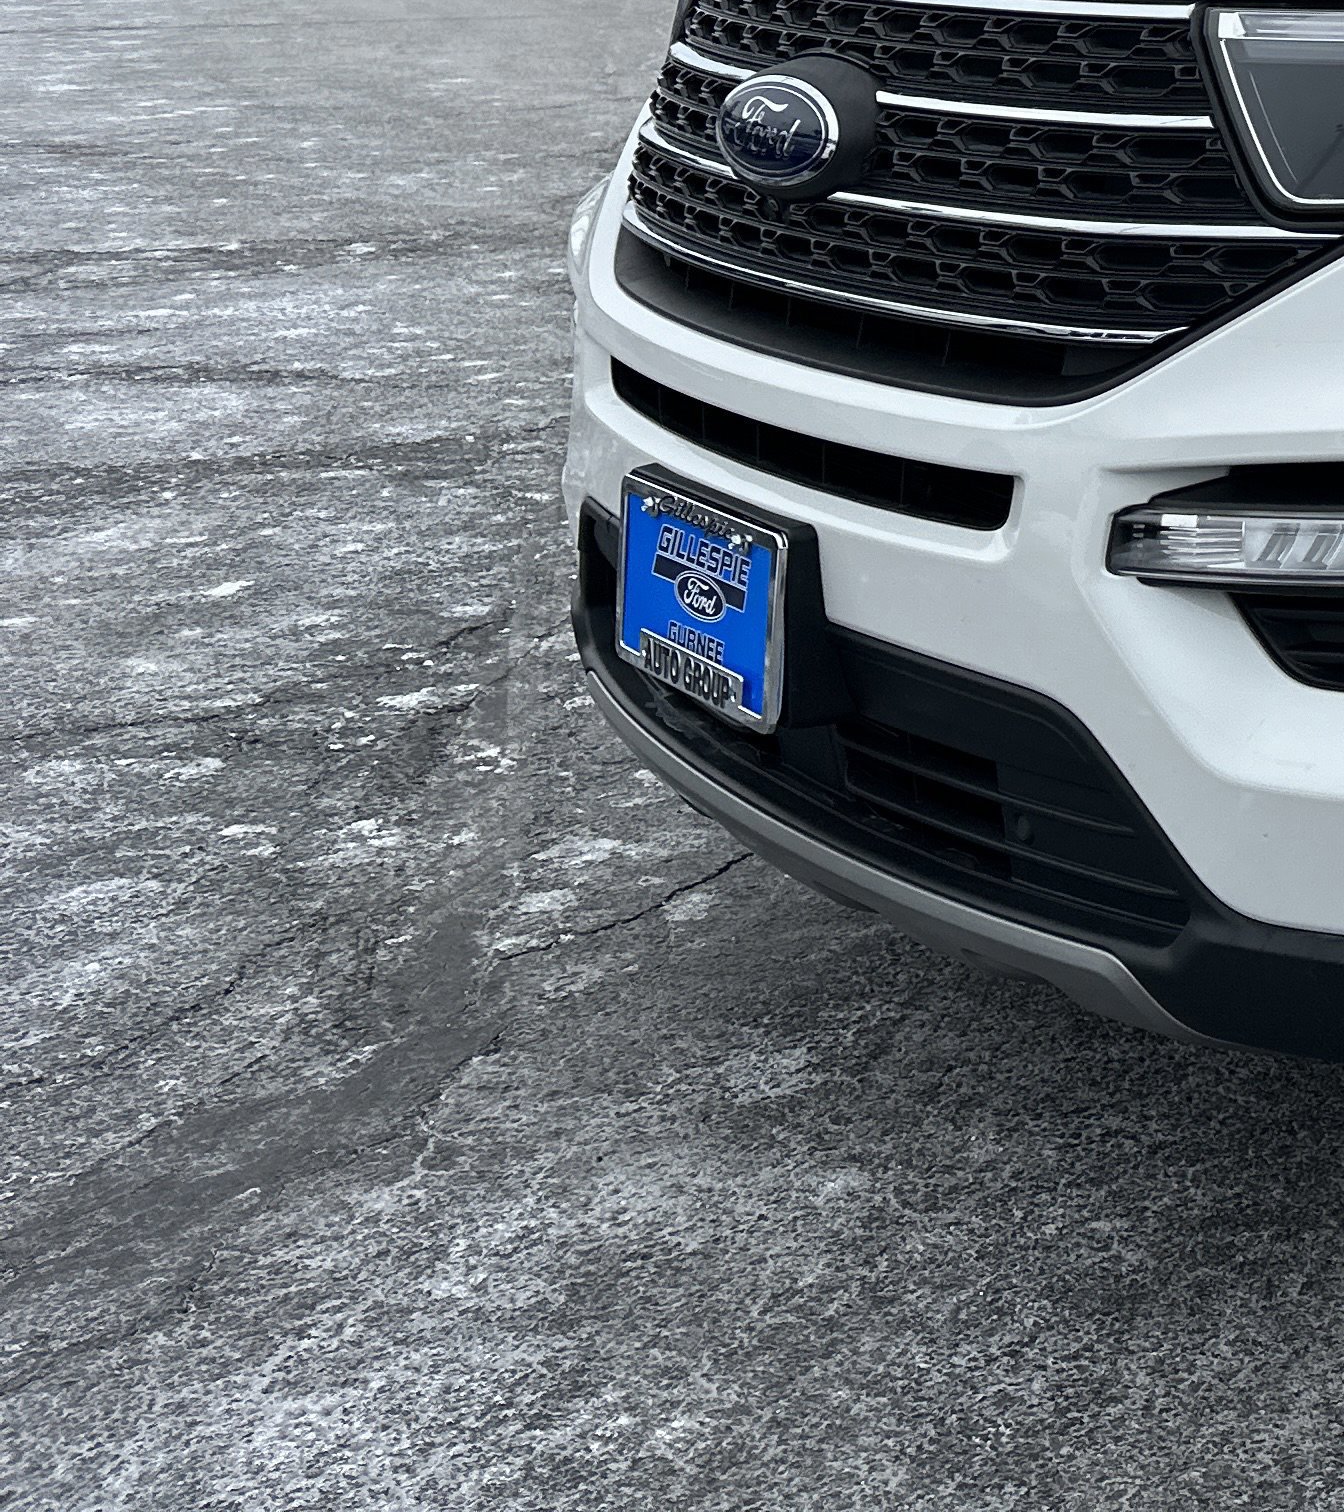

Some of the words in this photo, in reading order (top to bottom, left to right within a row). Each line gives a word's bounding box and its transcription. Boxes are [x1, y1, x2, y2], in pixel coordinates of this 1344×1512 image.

[730, 95, 801, 160] Ford
[660, 494, 734, 541] Gillespie
[657, 524, 752, 588] GILLESPIE
[683, 576, 717, 616] Ford
[668, 622, 725, 665] GURNEE
[643, 638, 679, 684] AUTO
[683, 655, 731, 709] GROUP
